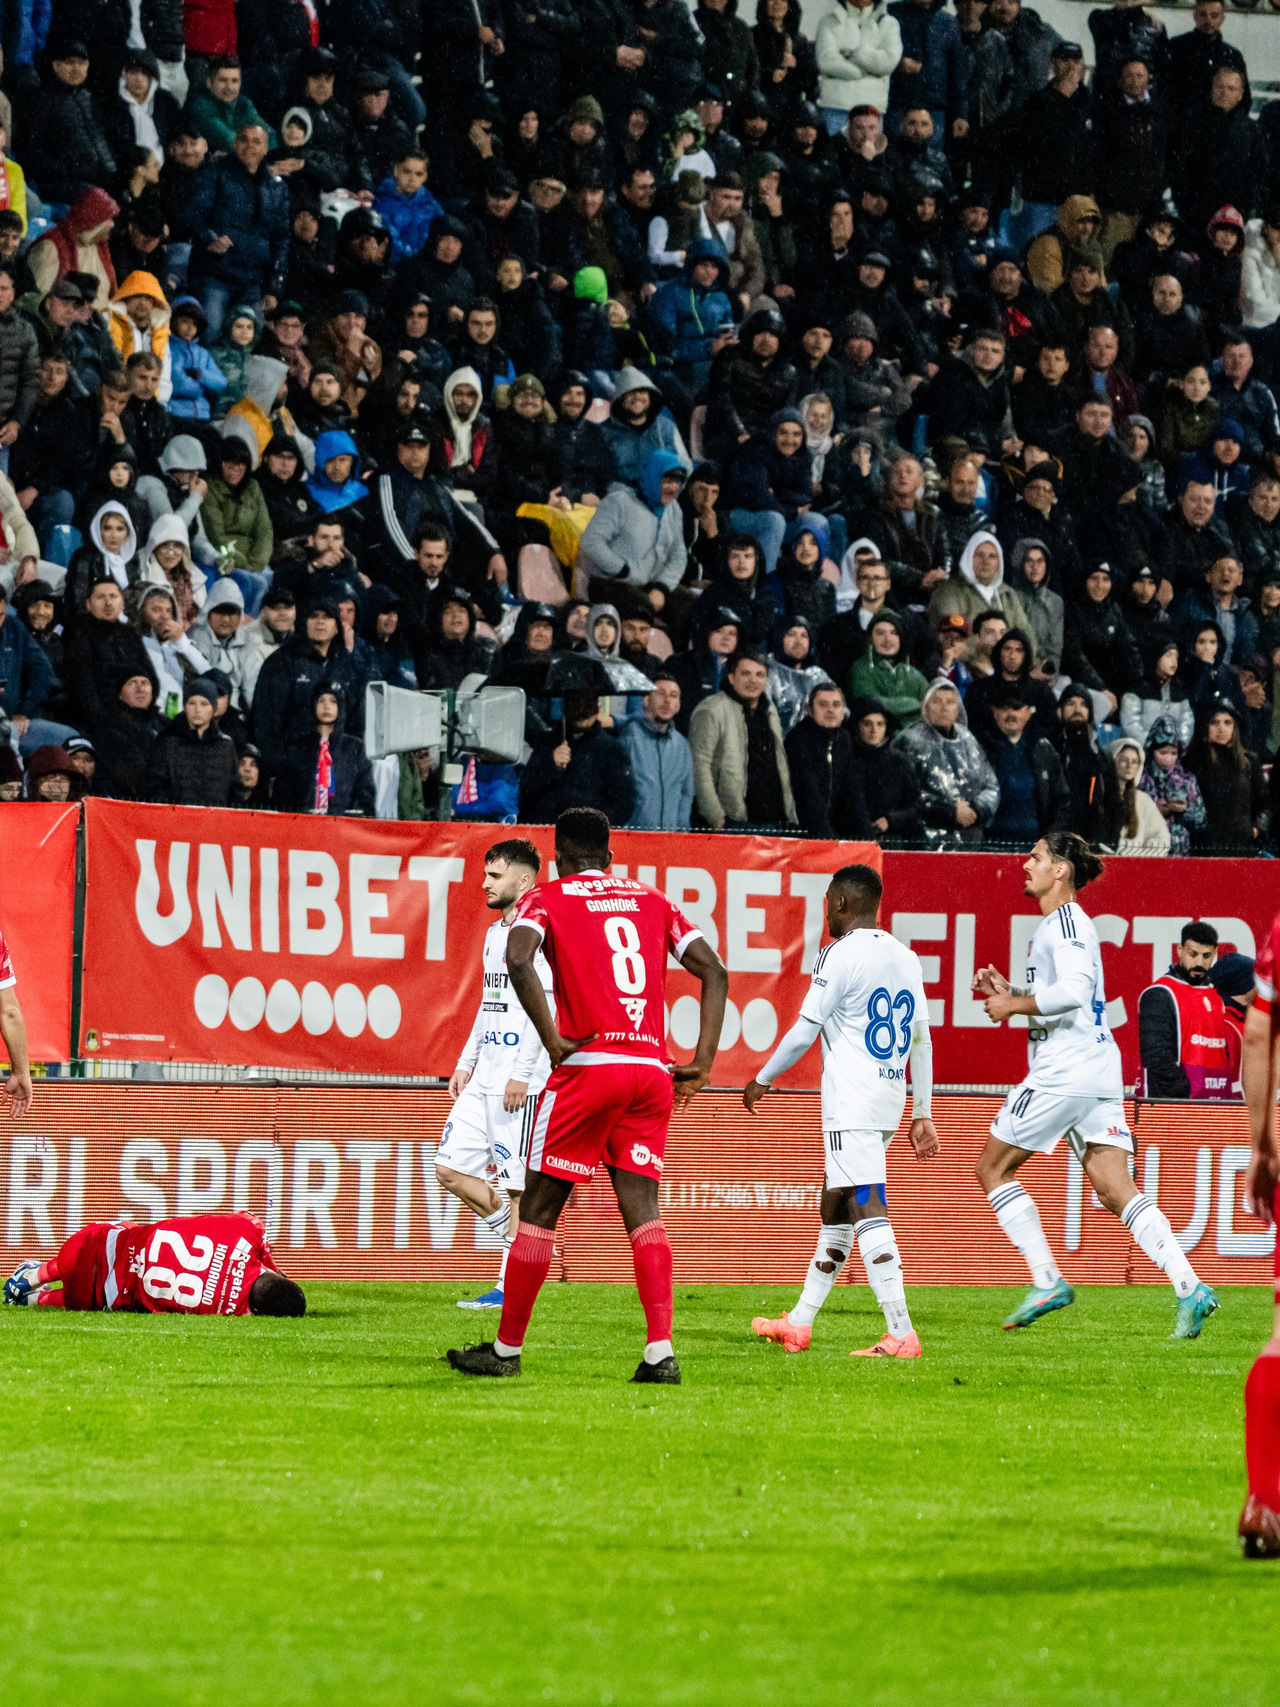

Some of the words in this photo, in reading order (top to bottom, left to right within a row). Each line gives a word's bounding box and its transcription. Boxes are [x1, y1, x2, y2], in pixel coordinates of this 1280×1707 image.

[135, 839, 464, 961] UNIBET
[571, 878, 641, 891] Regata.ro
[603, 916, 647, 995] 8
[604, 1031, 626, 1041] 7777
[864, 987, 916, 1060] 83
[1204, 1077, 1228, 1089] STAFF
[117, 1134, 504, 1252] SPORTIV
[545, 1155, 596, 1176] CARPATINA
[143, 1228, 214, 1308] 28
